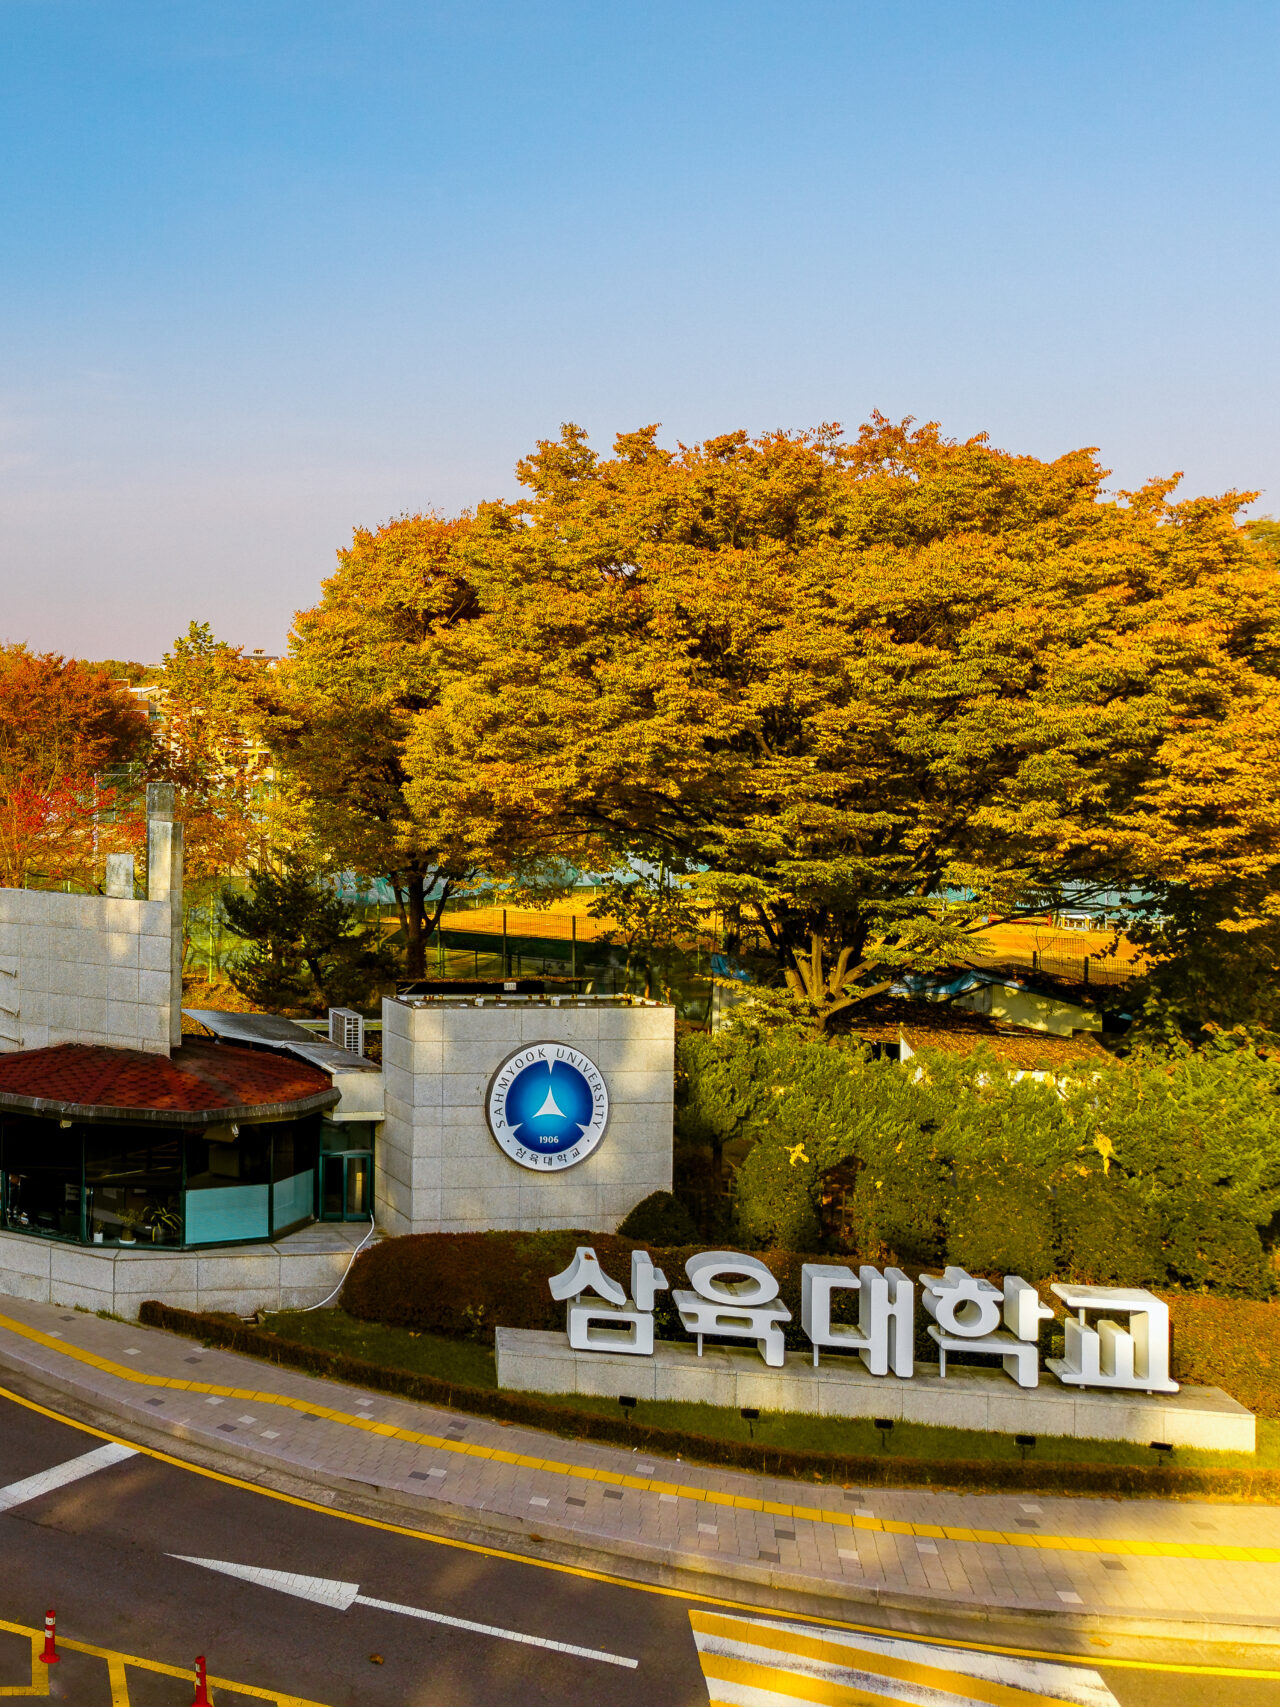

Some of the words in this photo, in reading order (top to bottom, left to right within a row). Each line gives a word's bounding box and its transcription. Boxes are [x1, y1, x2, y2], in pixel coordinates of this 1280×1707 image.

[493, 1047, 546, 1129] SAHMYOOK
[556, 1047, 605, 1129] UNIVERSITY
[515, 1147, 581, 1167] 삼육대학교
[539, 1136, 559, 1144] 1906
[548, 1246, 1180, 1394] 삼육대학교
